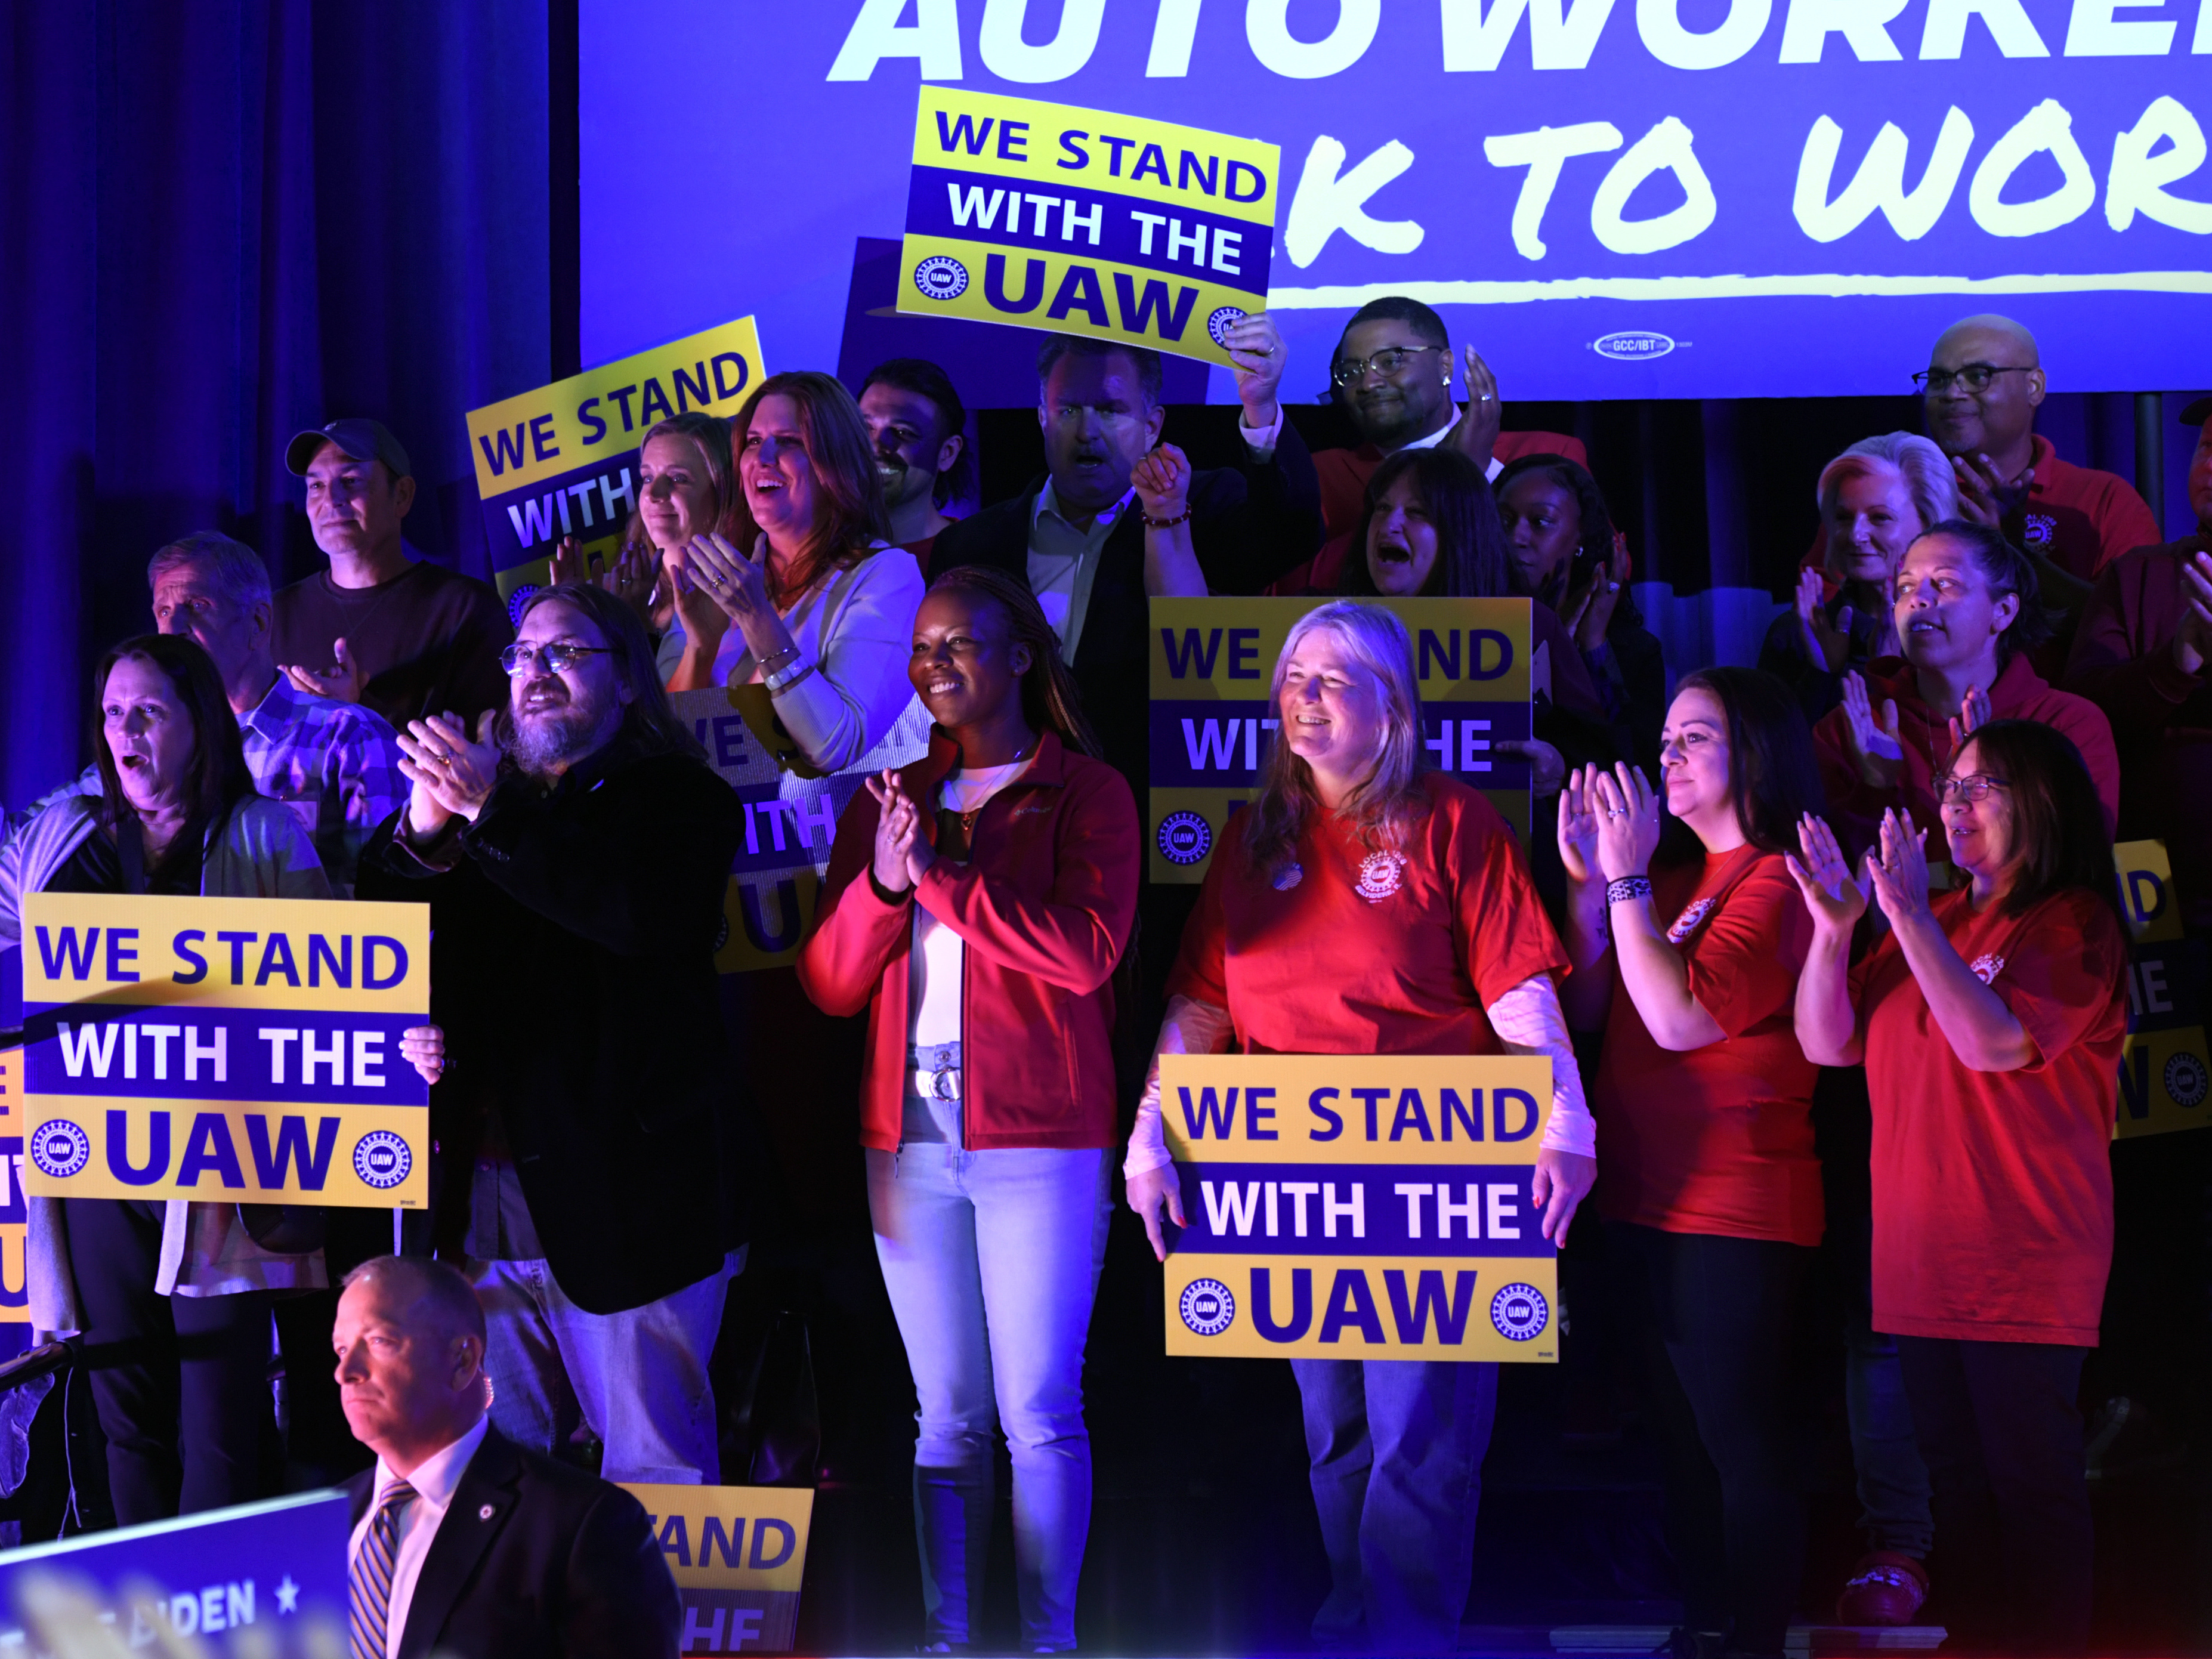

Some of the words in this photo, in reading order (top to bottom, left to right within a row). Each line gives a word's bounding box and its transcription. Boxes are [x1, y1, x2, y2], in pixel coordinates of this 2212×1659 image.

[1439, 0, 2212, 71] WORKE
[935, 110, 1030, 162] WE
[1056, 129, 1267, 203] STAND
[1484, 116, 1716, 260] TO
[947, 183, 1102, 245] WITH
[1130, 211, 1242, 276] THE
[931, 273, 952, 283] UAW
[984, 253, 1200, 342] UAW
[1613, 339, 1655, 351] GCC/IBT
[478, 413, 560, 477] WE
[577, 351, 749, 446] STAND
[507, 467, 635, 549] WITH
[1160, 628, 1261, 680] WE
[1181, 719, 1280, 770] WI
[1425, 720, 1491, 771] HE
[743, 794, 836, 854] ITH
[1173, 833, 1195, 844] UAW
[1358, 849, 1389, 869] LOCAL
[1372, 869, 1390, 879] UAW
[34, 926, 140, 983] WE
[171, 929, 409, 990] STAND
[57, 1022, 227, 1082] WITH
[259, 1028, 385, 1087] THE
[1178, 1086, 1278, 1141] WE
[1308, 1087, 1539, 1143] STAND
[48, 1143, 71, 1155] UAW
[106, 1110, 341, 1191] UAW
[370, 1154, 393, 1166] UAW
[1201, 1181, 1365, 1238] WITH
[1394, 1183, 1520, 1239] THE
[1196, 1302, 1218, 1313] UAW
[1250, 1267, 1478, 1345] UAW
[1507, 1306, 1530, 1318] UAW
[648, 1514, 796, 1570] AND
